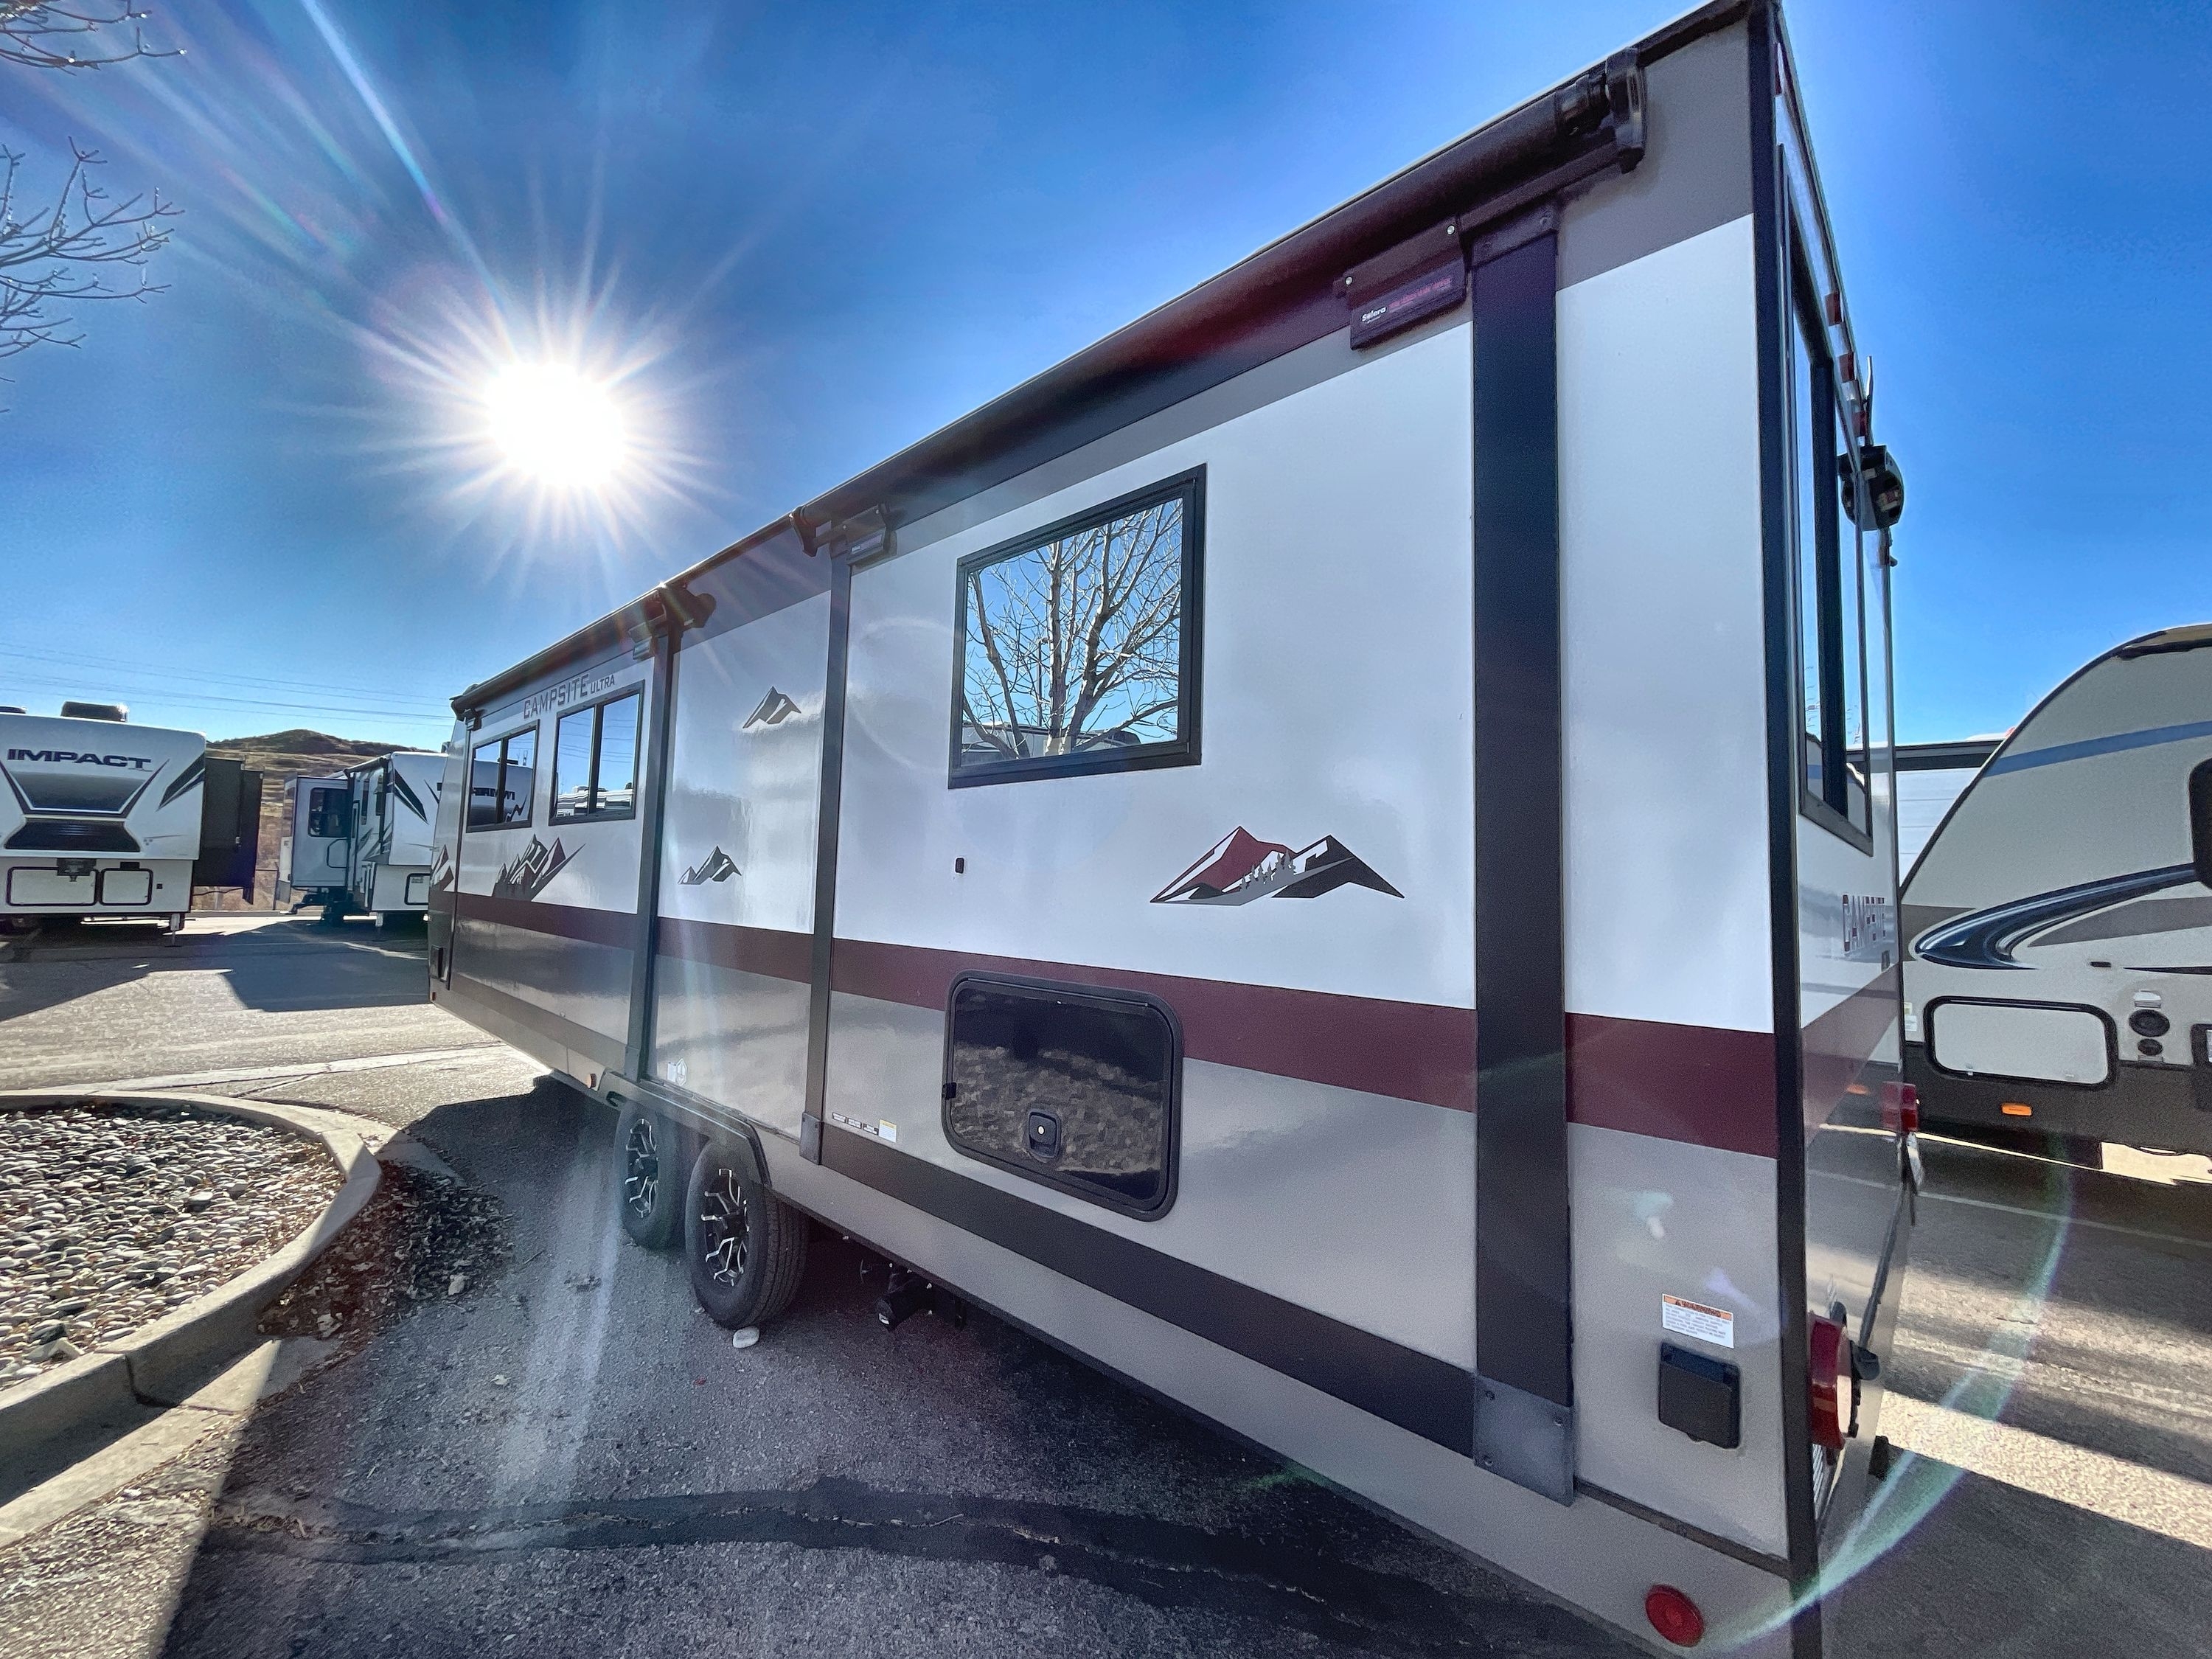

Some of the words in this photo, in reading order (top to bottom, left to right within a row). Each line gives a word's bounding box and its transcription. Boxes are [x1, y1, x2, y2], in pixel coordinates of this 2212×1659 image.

[1361, 307, 1386, 321] Solera
[524, 674, 589, 719] CAMPSITE
[591, 675, 615, 695] ULTRA
[7, 748, 151, 768] IMPACT
